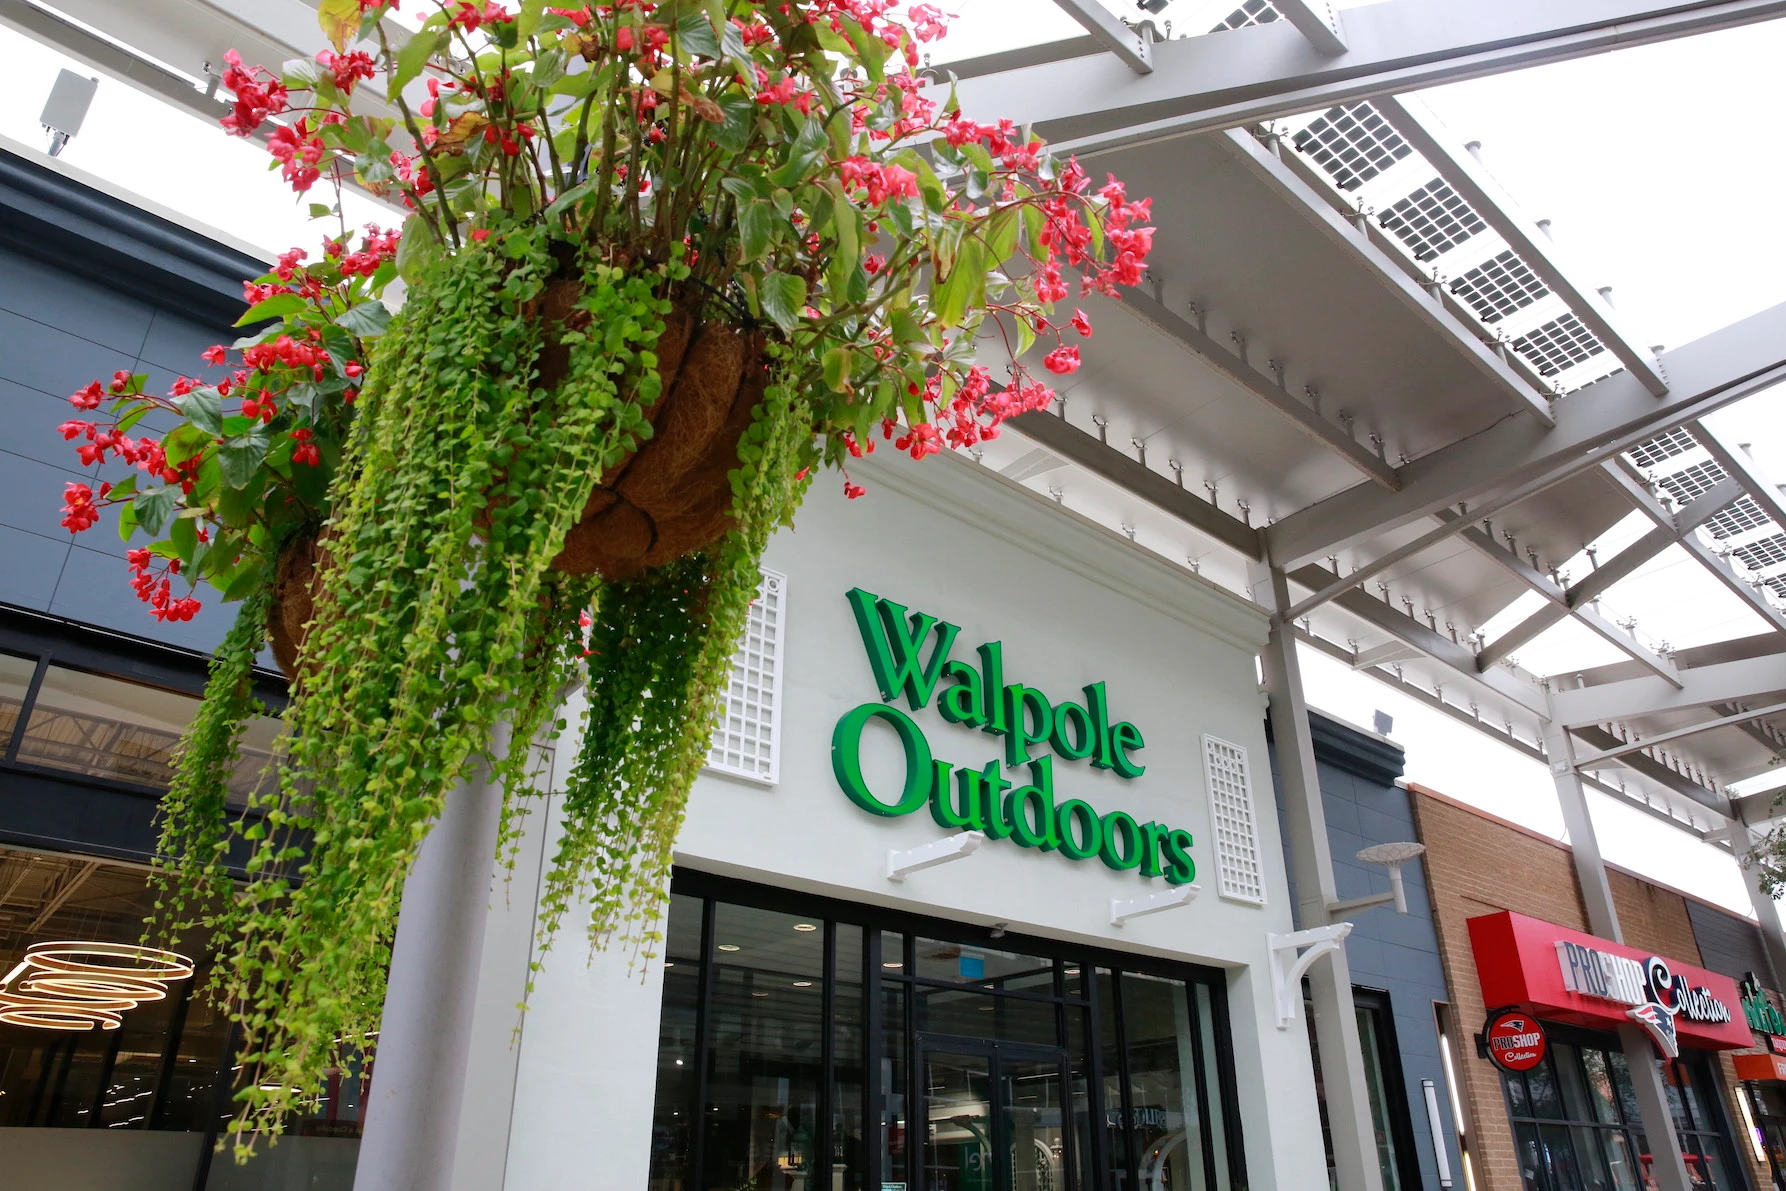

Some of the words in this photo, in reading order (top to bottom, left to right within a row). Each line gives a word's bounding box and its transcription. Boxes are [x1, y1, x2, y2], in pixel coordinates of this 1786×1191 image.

[846, 587, 1145, 778] Walpole
[832, 703, 1196, 884] Outdoors
[1643, 956, 1731, 1023] Collection
[1505, 1052, 1537, 1062] Collection
